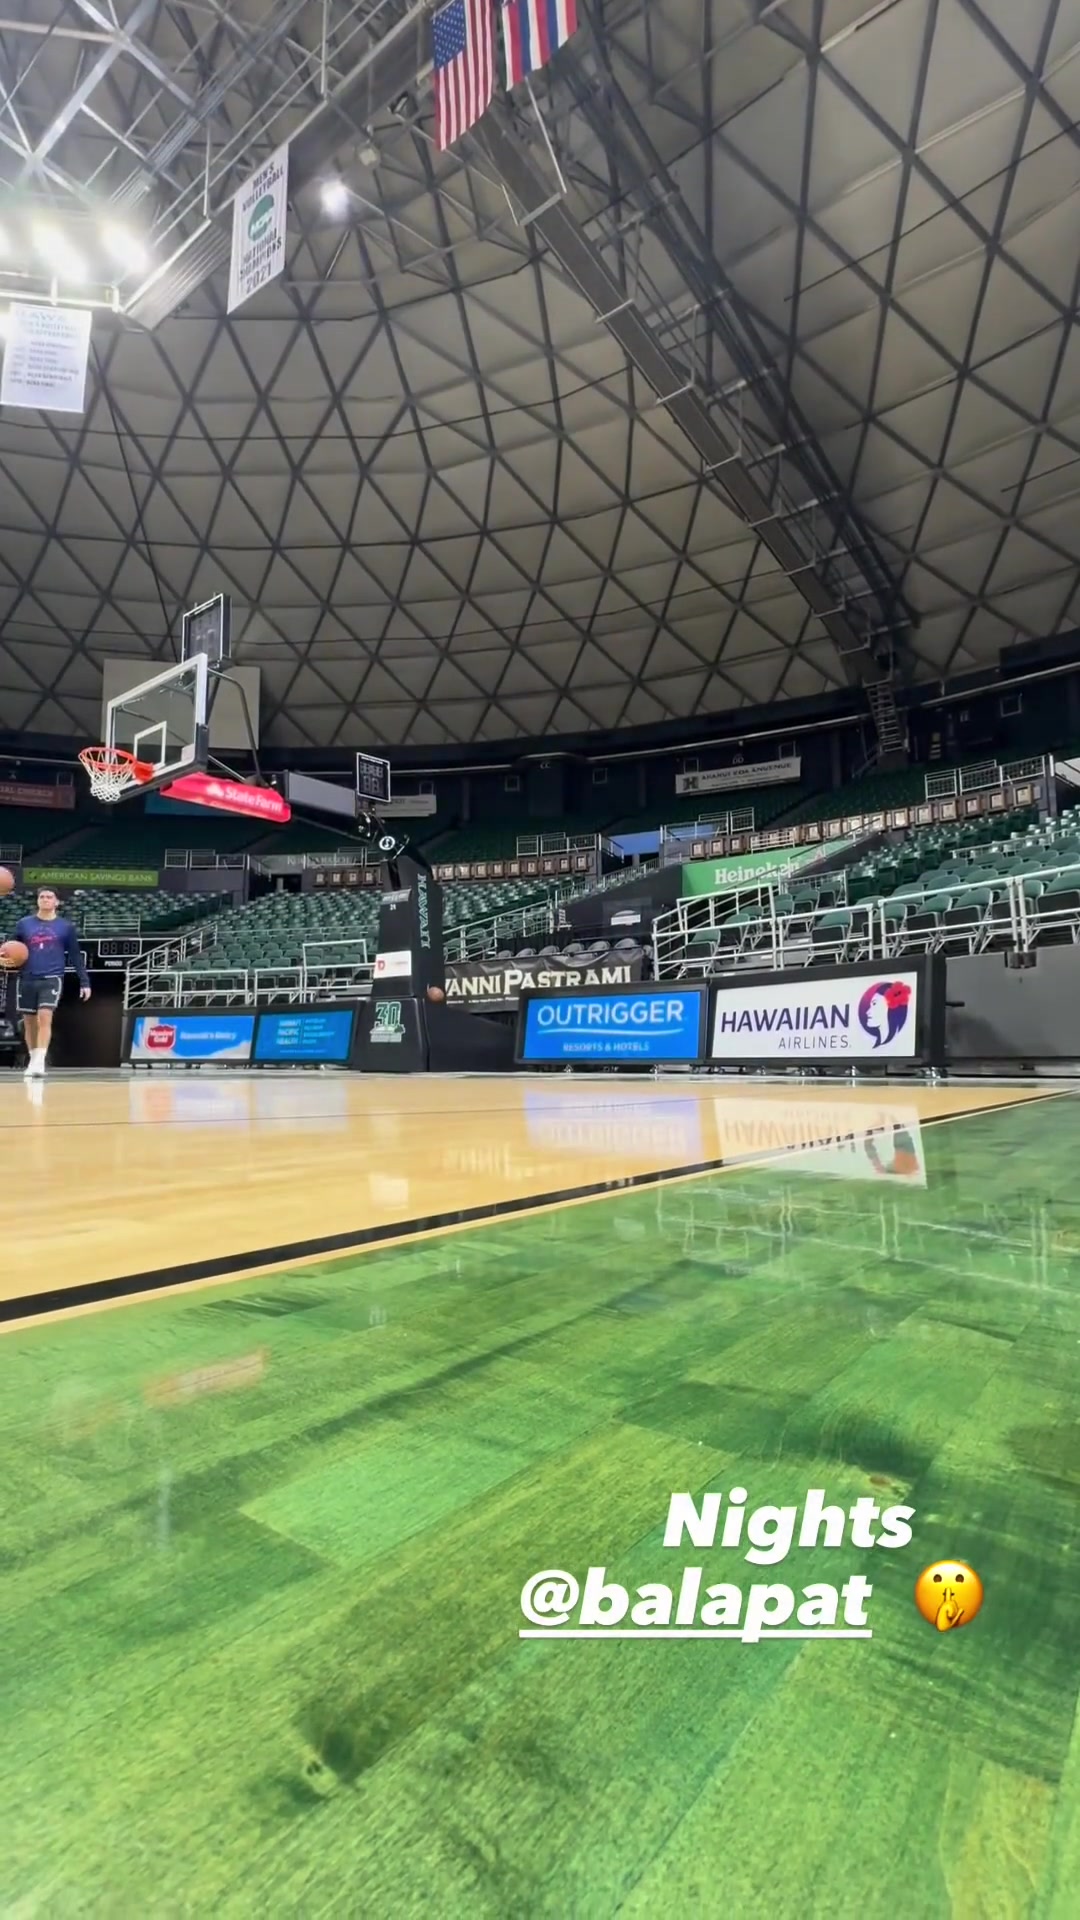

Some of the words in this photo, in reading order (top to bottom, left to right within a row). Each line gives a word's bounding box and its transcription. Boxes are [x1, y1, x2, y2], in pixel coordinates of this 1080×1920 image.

[246, 261, 271, 294] 2021
[40, 871, 88, 881] AMERICAN
[90, 872, 126, 882] SAVINGS
[127, 874, 153, 883] BANK
[537, 1000, 684, 1026] OUTRIGGER
[721, 1003, 850, 1033] HAWAIIAN
[563, 1041, 603, 1052] RESORTS
[604, 1041, 611, 1051] &
[613, 1041, 650, 1051] HOTELS
[778, 1034, 850, 1050] AIRLINES
